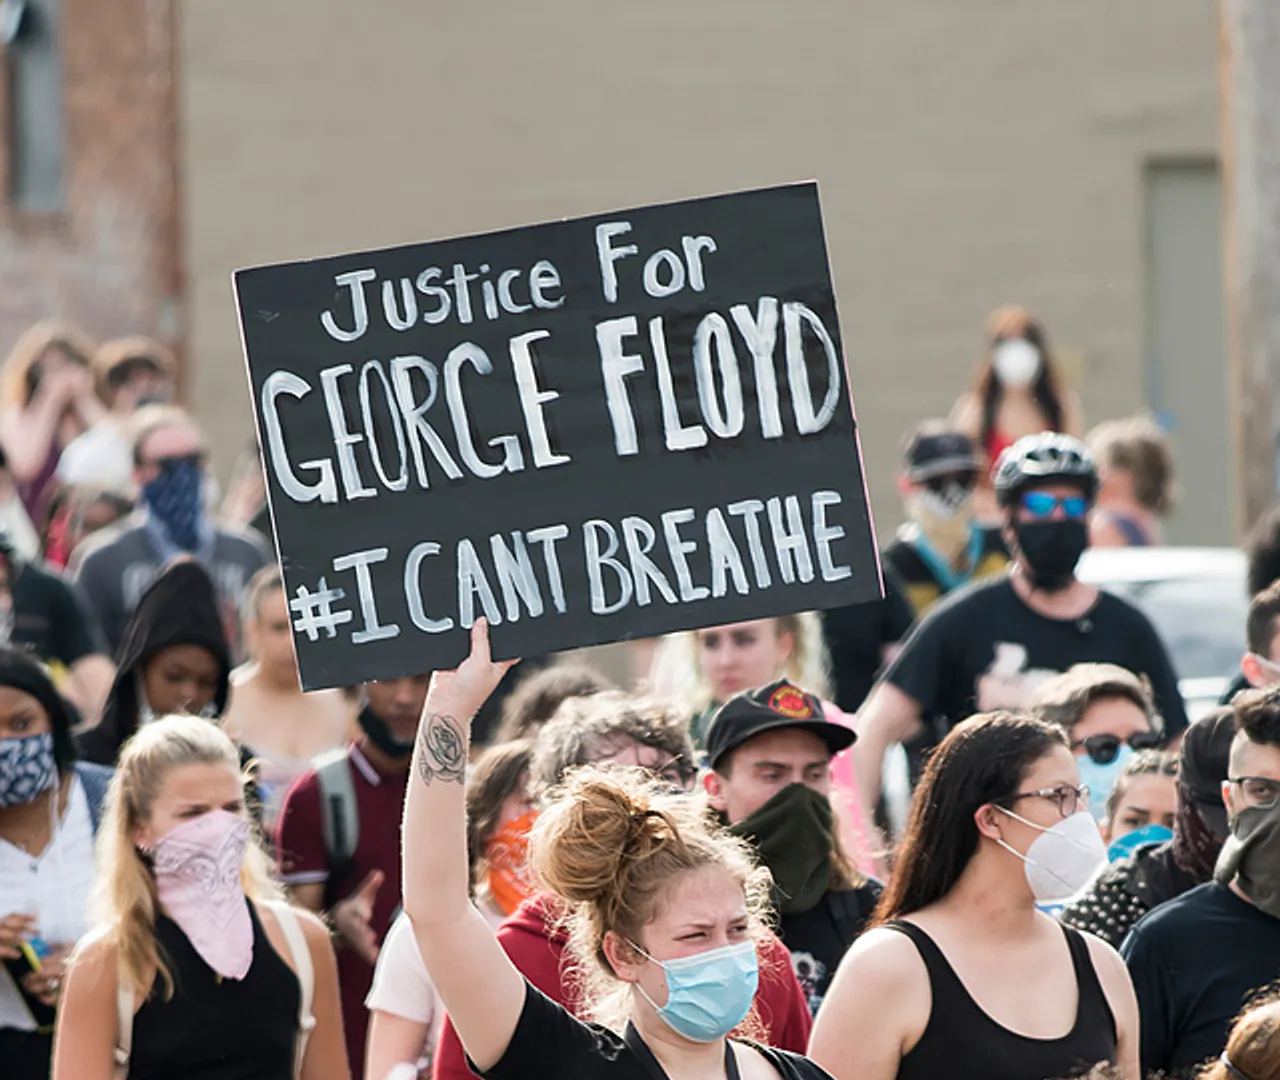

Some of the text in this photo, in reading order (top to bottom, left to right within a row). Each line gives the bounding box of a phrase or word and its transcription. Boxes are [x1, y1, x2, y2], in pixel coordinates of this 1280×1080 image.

[596, 221, 718, 303] For
[261, 297, 841, 504] GEORGE FLOYD
[404, 524, 569, 635] CANT
[582, 490, 852, 616] BREATHE
